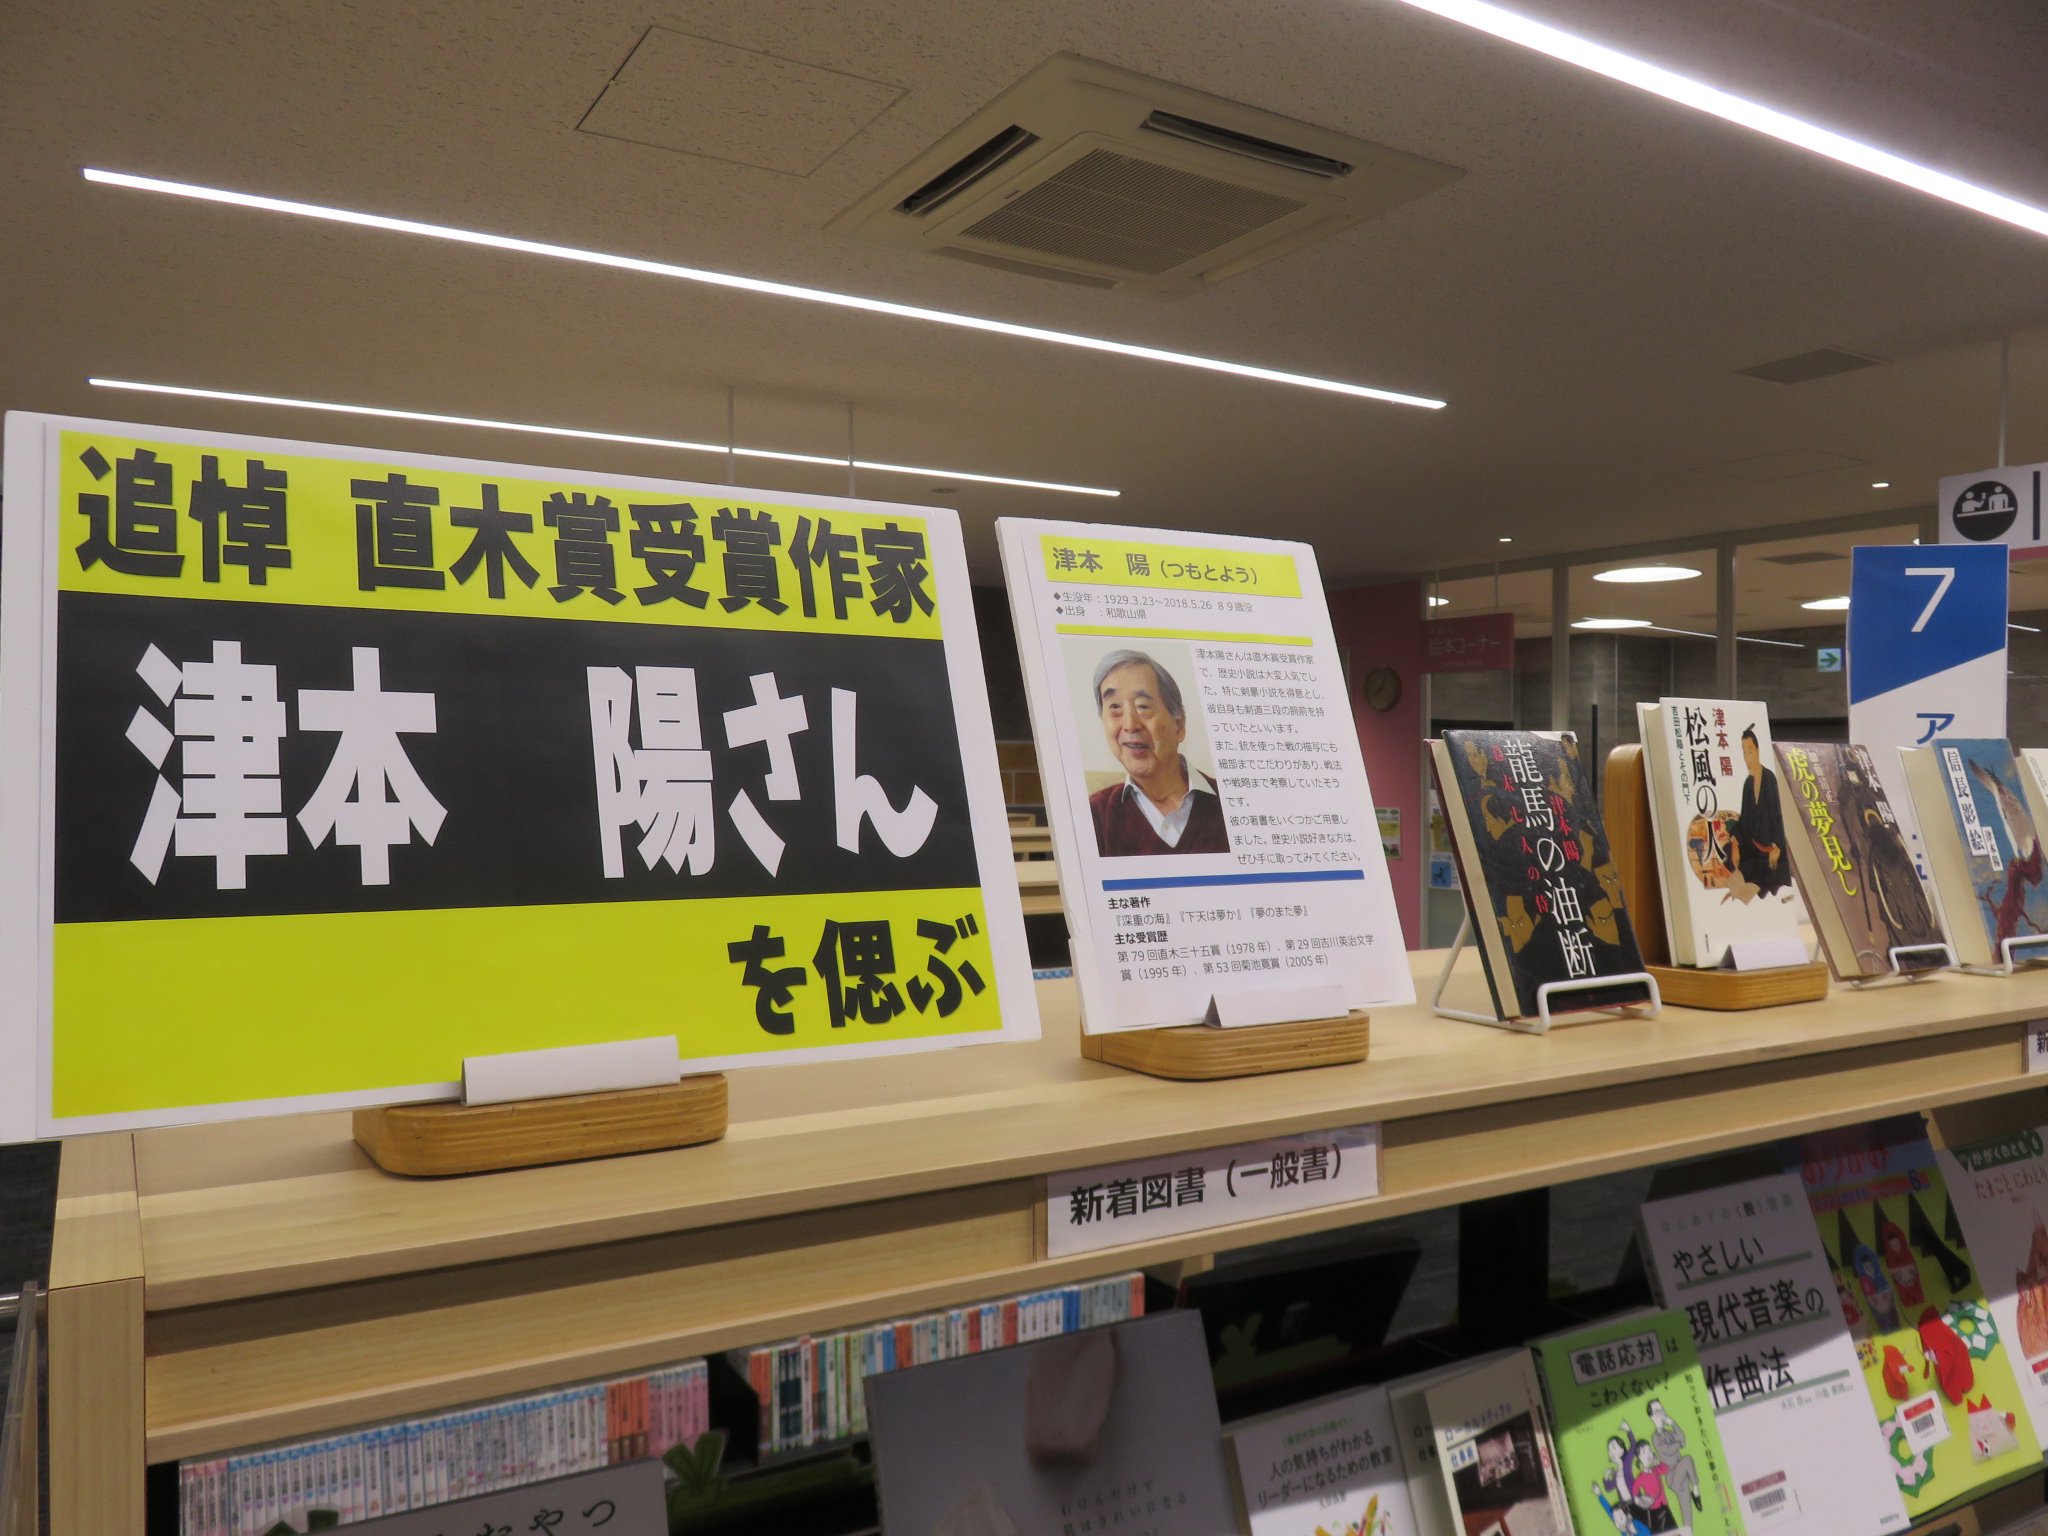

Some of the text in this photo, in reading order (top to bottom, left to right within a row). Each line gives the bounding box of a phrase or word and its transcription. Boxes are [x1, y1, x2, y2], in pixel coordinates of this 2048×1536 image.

[74, 448, 937, 624] 追悼 直木賞受賞作家
[1052, 545, 1102, 574] 津本
[1905, 567, 1956, 633] 7
[1065, 605, 1086, 618] 出身
[1195, 647, 1315, 665] 津本陽さんは直木賞受賞作家
[1200, 667, 1317, 683] で、歴史小説は大変人気でし
[1207, 703, 1325, 718] 彼自身も剣道三段の腕前を持
[1212, 722, 1299, 734] っていたといいます。
[1215, 741, 1338, 753] また、銃を使った戦の描写にも
[124, 640, 939, 889] 津本 陽さん
[1218, 758, 1343, 771] 細部までこだわりがあり、戦法
[1222, 777, 1341, 789] や戦略まで考察していたそう
[1683, 706, 1729, 864] 松風の人
[1225, 797, 1250, 807] です。
[1230, 814, 1349, 827] 彼の著書をいくつかご用意し
[1549, 794, 1582, 862] 津本陽
[1234, 832, 1357, 846] ました。歴史小説好きな方は、
[1237, 851, 1361, 865] ぜひ手に取ってみてください。
[1503, 739, 1597, 980] 龍馬の油断
[1108, 897, 1151, 910] 主な著作
[1114, 930, 1169, 946] 主な受賞歴
[728, 912, 987, 1036] を偲ぶ
[1069, 1143, 1342, 1226] 新着図書（一般書）
[1673, 1236, 1764, 1282] やさしい
[1686, 1279, 1824, 1344] 現代音楽の
[1576, 1336, 1679, 1377] 電話応対 は
[1706, 1346, 1795, 1409] 作曲法
